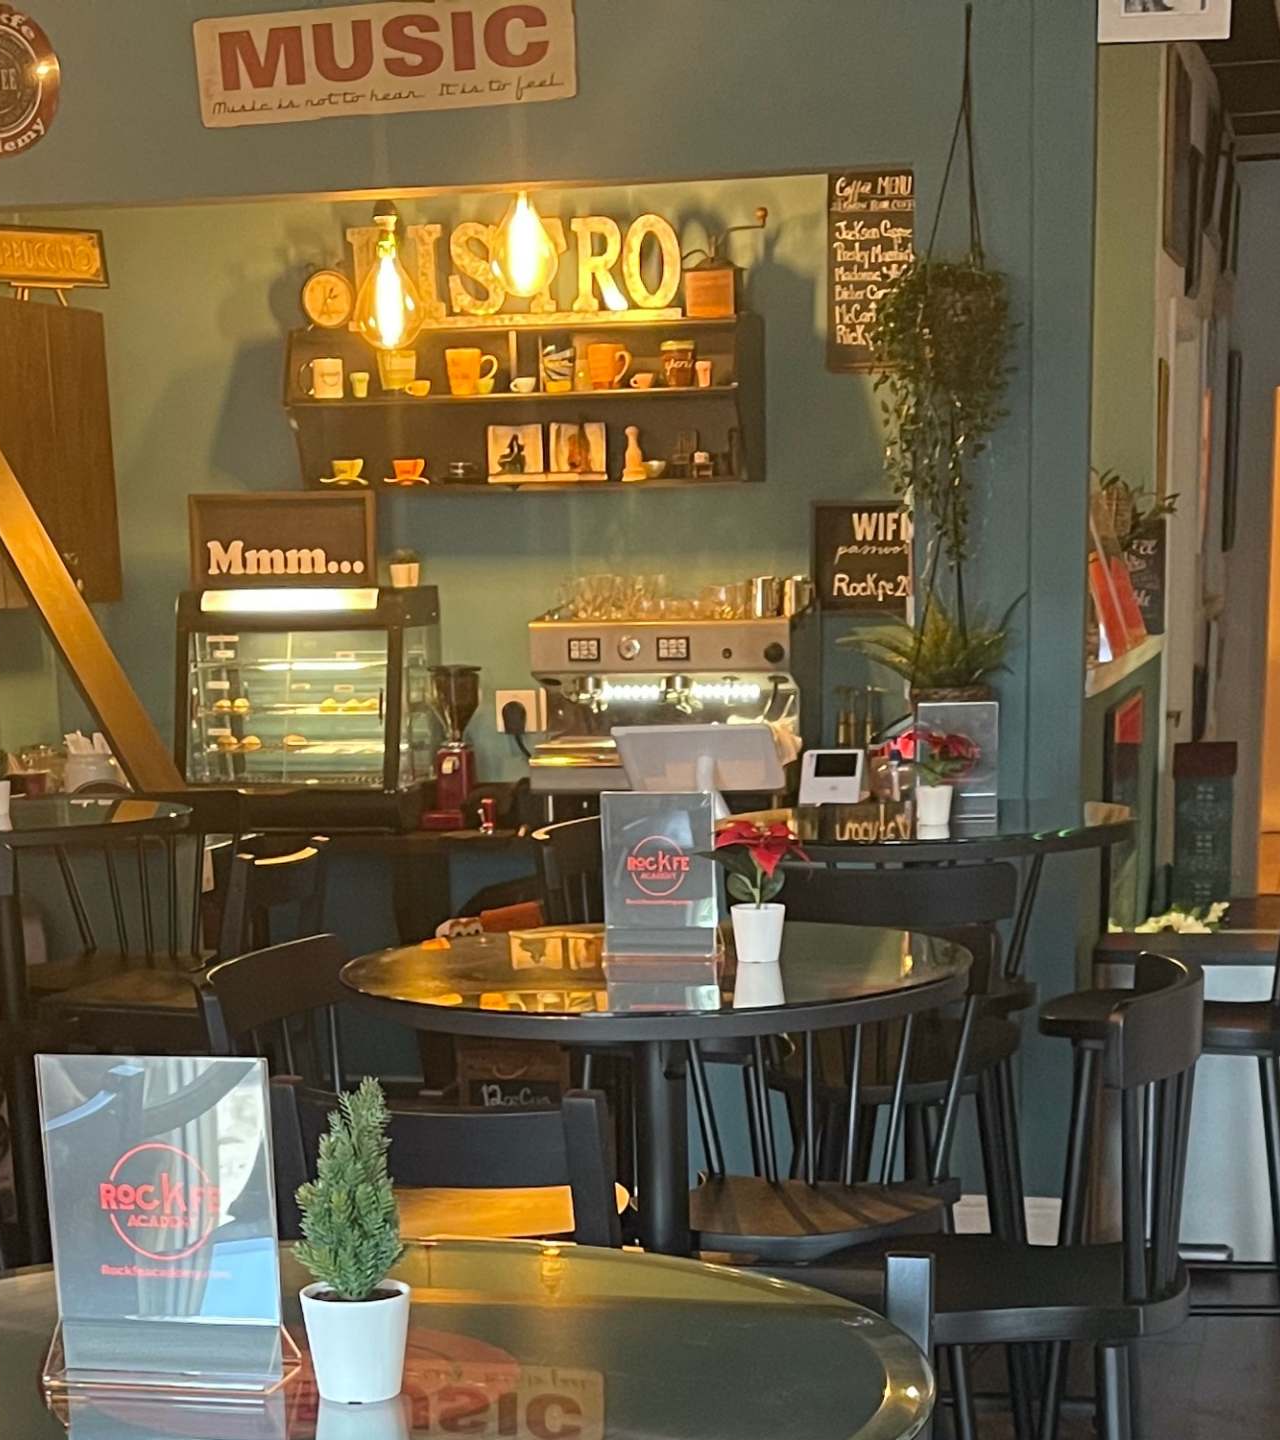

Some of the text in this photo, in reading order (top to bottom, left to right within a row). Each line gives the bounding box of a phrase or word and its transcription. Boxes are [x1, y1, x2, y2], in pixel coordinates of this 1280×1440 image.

[217, 4, 550, 92] MUSIC
[212, 101, 273, 115] Music
[277, 99, 297, 110] is
[305, 93, 337, 106] not
[339, 92, 365, 104] to
[438, 82, 458, 96] It
[460, 83, 483, 95] is
[487, 79, 511, 92] to
[835, 174, 912, 202] Coffee MENU
[852, 512, 910, 541] WIFI
[207, 540, 365, 575] Mmm...
